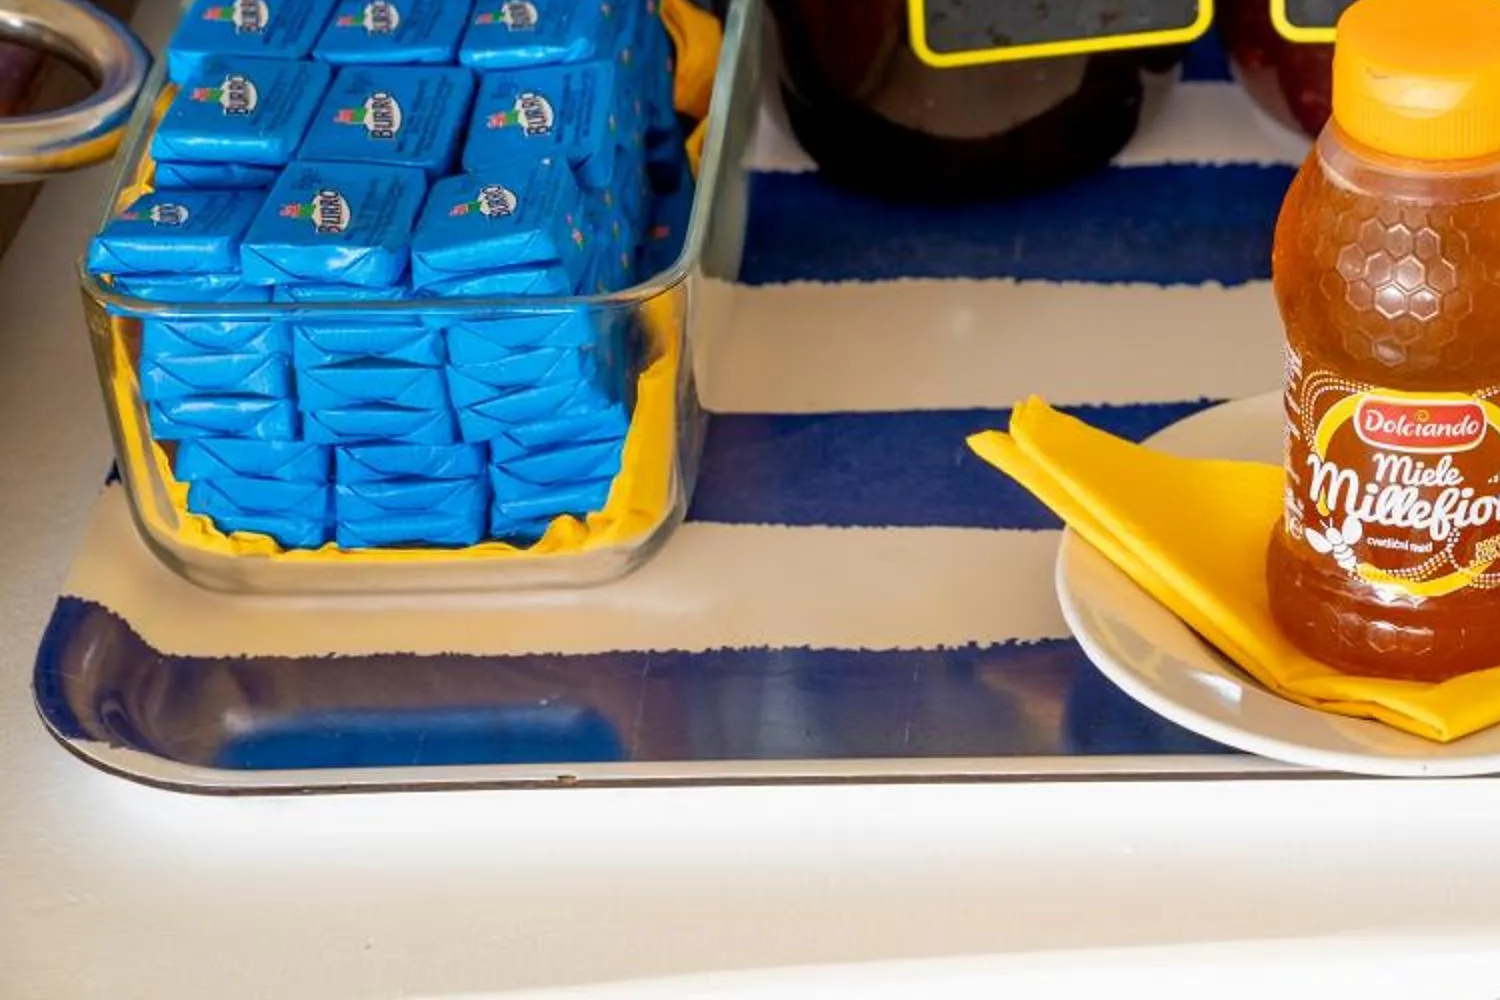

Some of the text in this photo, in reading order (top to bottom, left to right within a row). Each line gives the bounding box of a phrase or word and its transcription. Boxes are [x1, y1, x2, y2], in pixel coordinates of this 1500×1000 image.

[372, 92, 393, 138] BURRO
[1364, 408, 1480, 436] Dolciando
[1371, 453, 1464, 486] Miele
